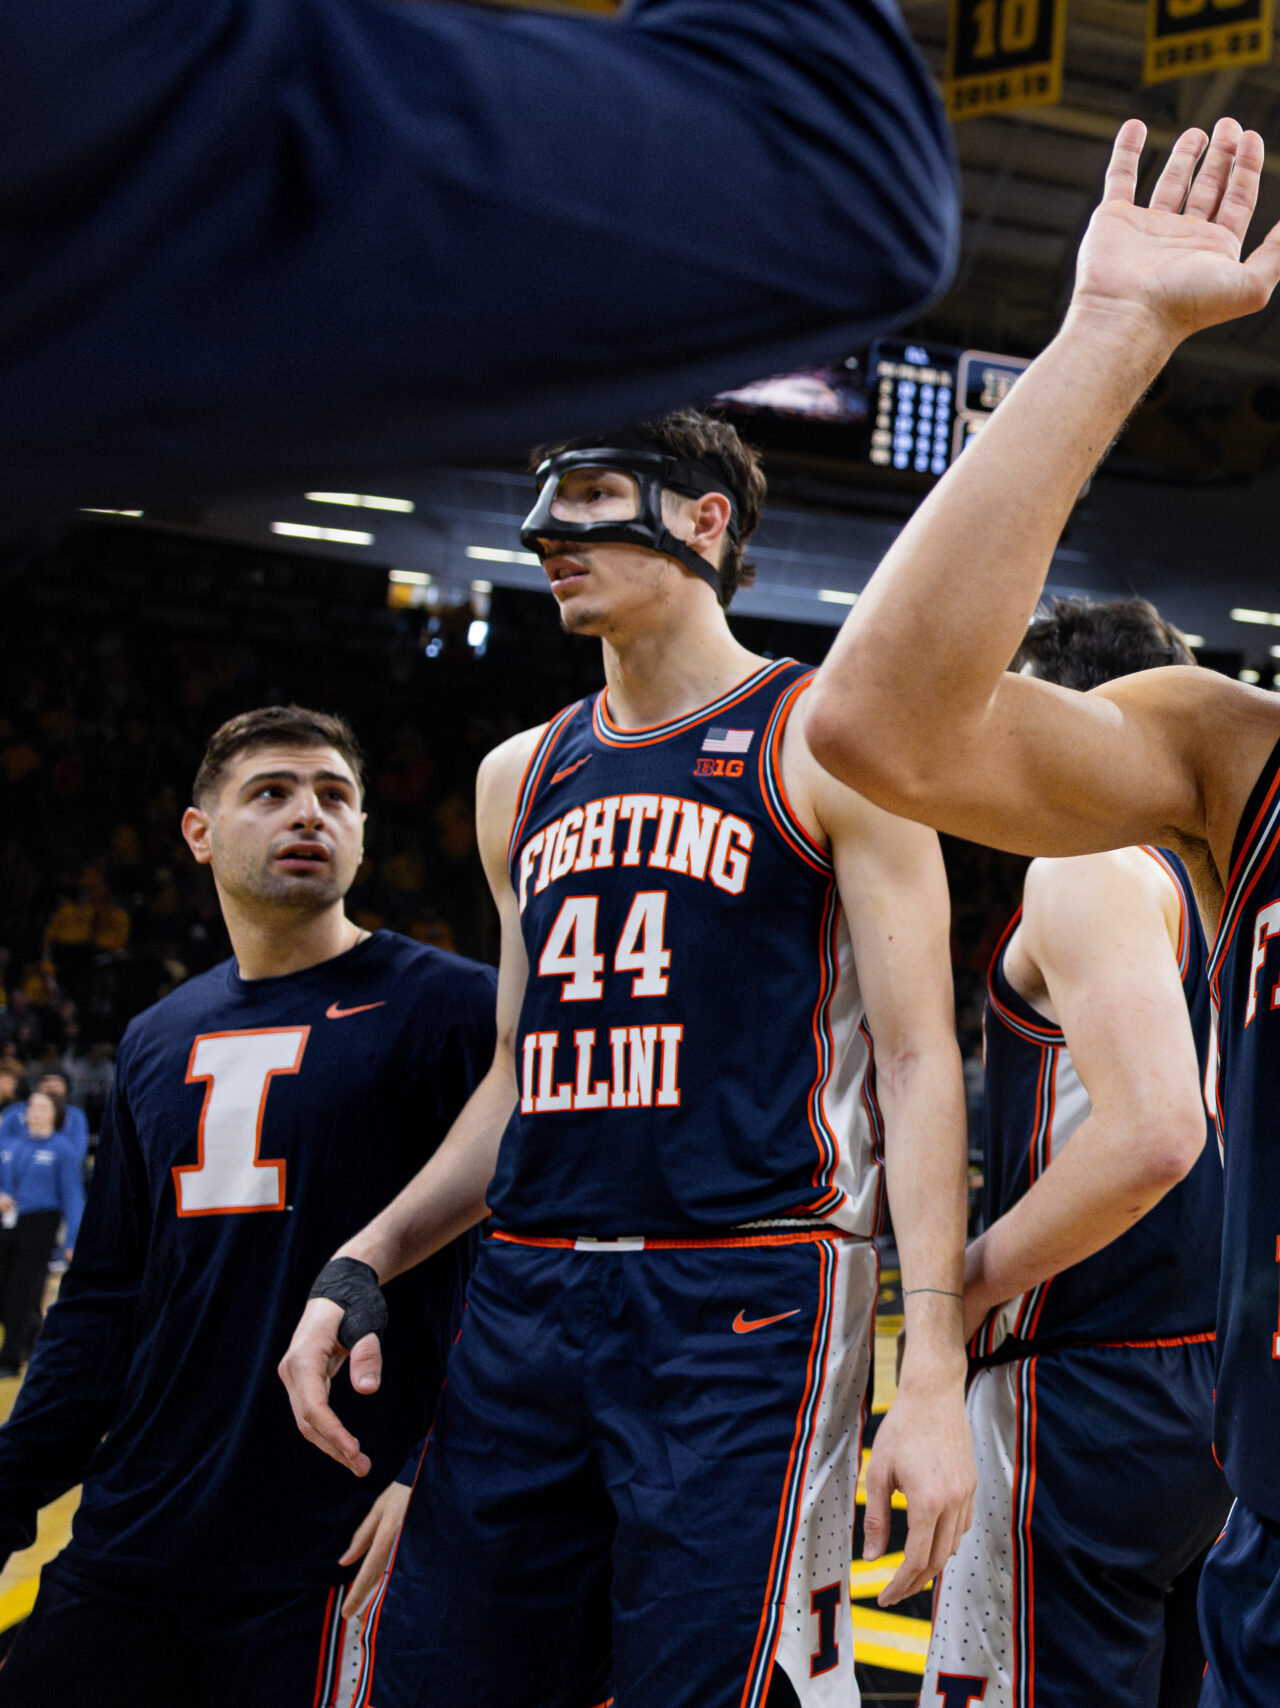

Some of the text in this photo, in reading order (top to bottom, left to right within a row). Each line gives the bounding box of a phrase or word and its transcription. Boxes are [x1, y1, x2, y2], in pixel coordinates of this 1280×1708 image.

[971, 0, 1040, 58] 10
[519, 793, 754, 916] FIGHTING
[538, 890, 671, 1002] 44
[171, 1025, 311, 1218] I
[520, 1024, 684, 1115] ILLINI
[810, 1581, 842, 1678] I
